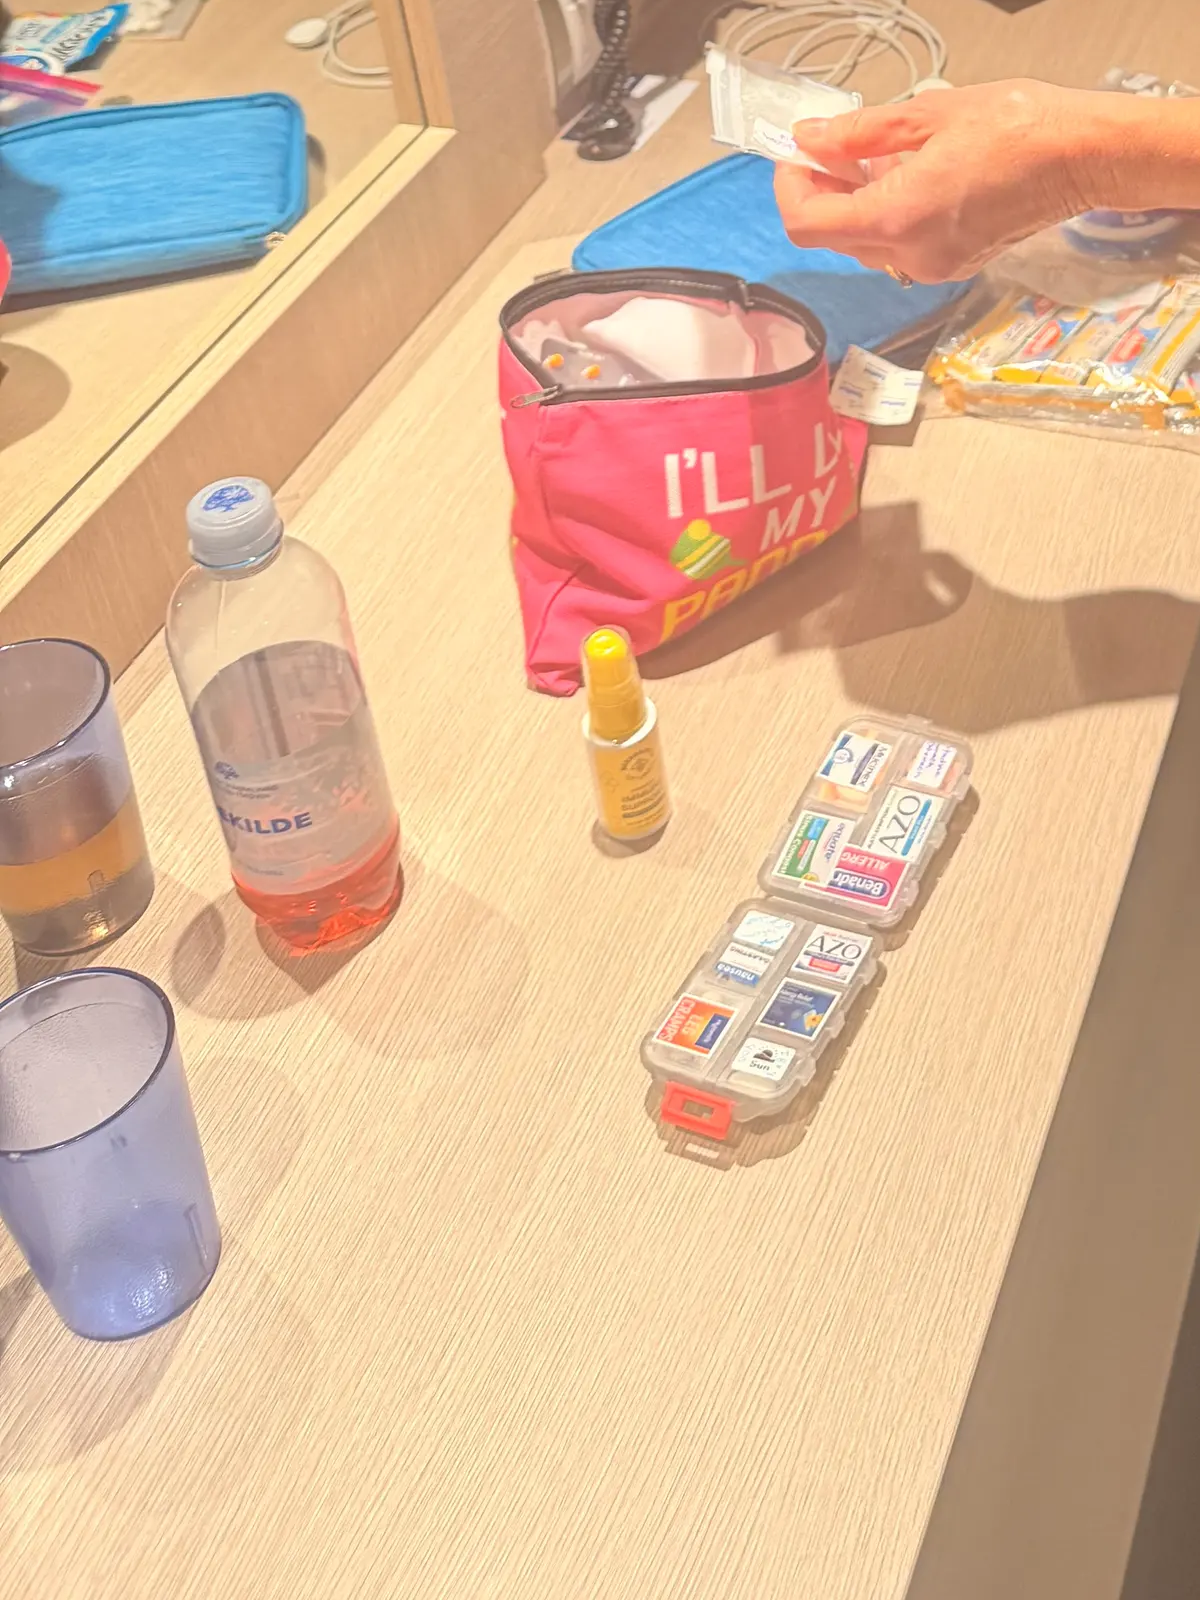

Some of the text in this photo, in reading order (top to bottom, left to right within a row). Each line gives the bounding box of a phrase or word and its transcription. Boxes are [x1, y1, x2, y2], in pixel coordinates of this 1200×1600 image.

[664, 445, 793, 519] I'LL
[759, 476, 837, 552] MY
[879, 795, 921, 854] AZO
[824, 822, 846, 862] equate
[833, 871, 884, 896] Benadr
[806, 934, 863, 961] AZO
[716, 962, 756, 982] nausea
[659, 1000, 697, 1042] CRAMPS
[681, 1013, 703, 1036] LEG
[749, 1059, 771, 1072] Sun
